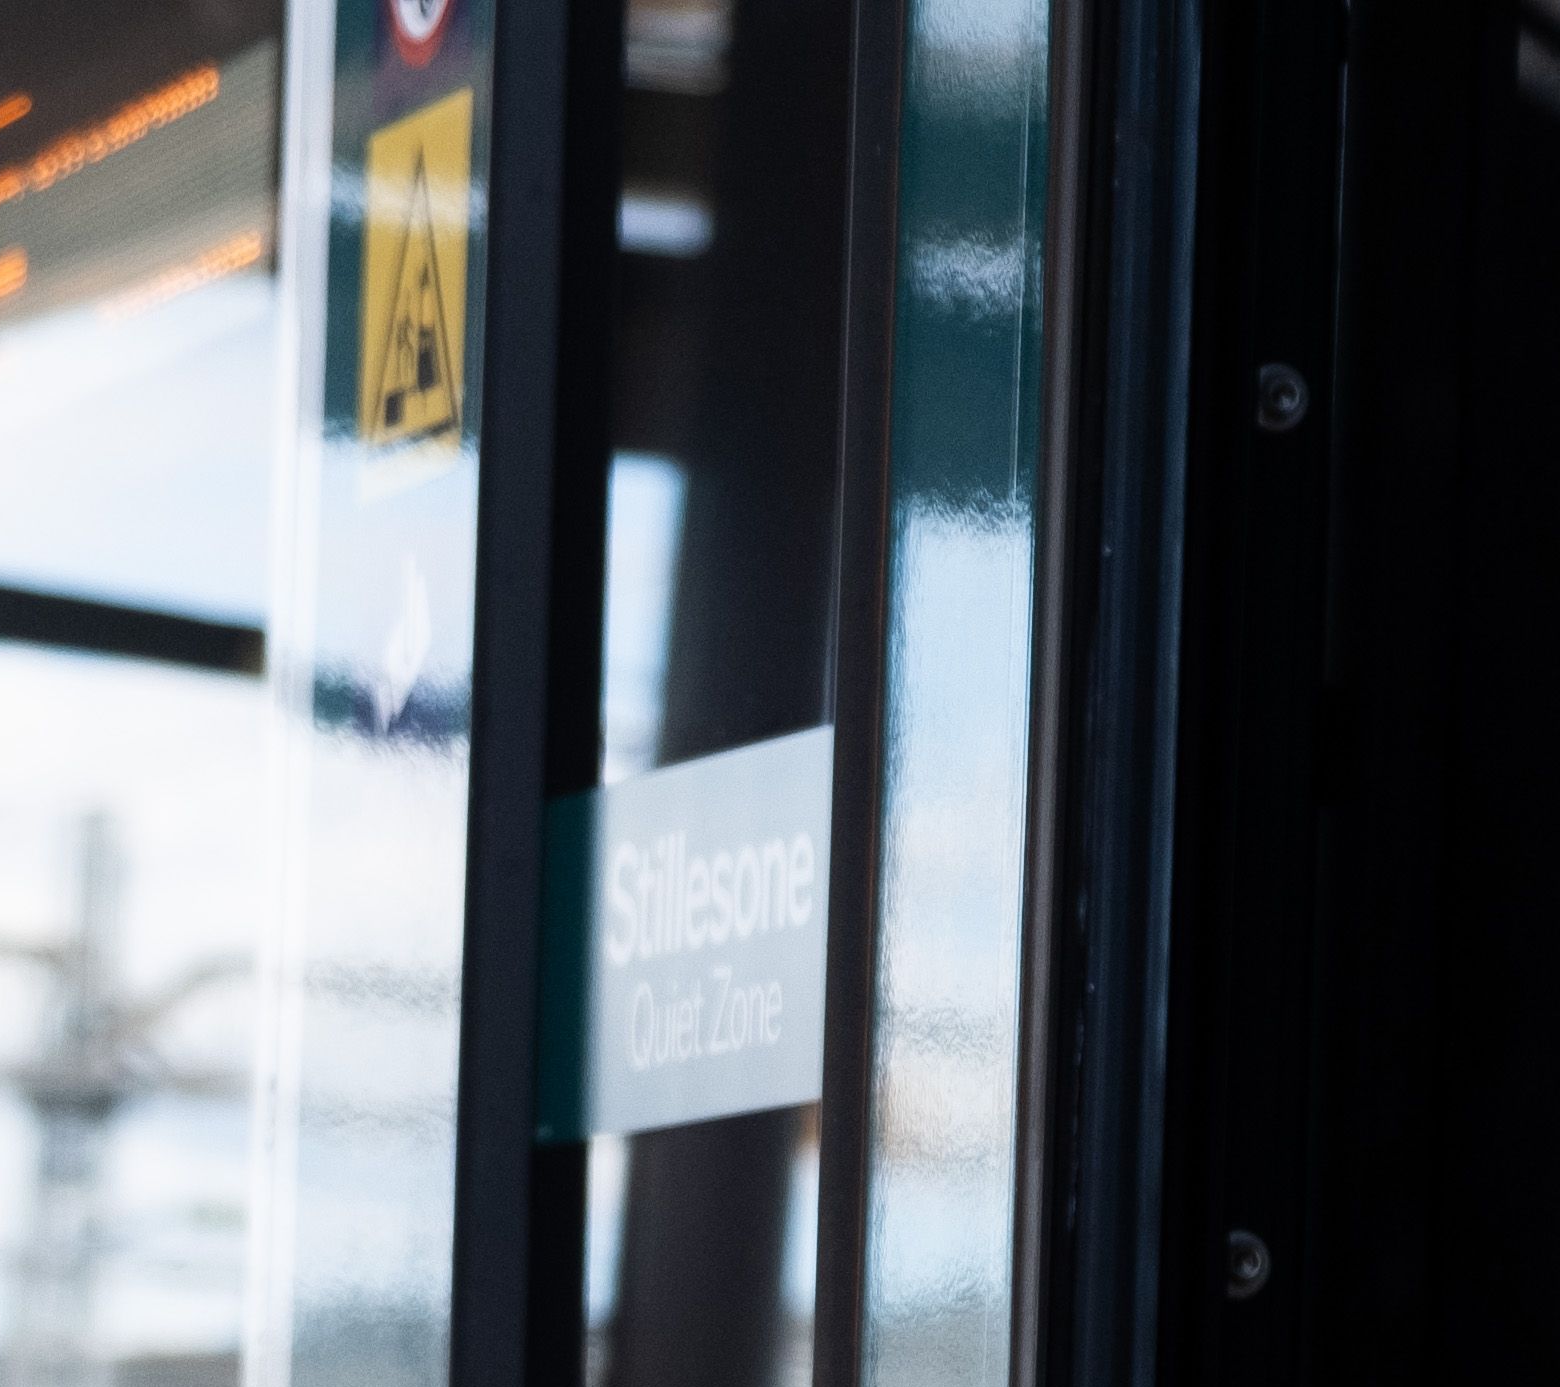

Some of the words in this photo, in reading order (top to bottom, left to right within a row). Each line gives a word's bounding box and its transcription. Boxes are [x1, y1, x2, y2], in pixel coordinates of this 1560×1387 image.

[605, 829, 816, 967] Stillesone
[631, 978, 703, 1072] Quiet
[708, 963, 783, 1054] Zone
